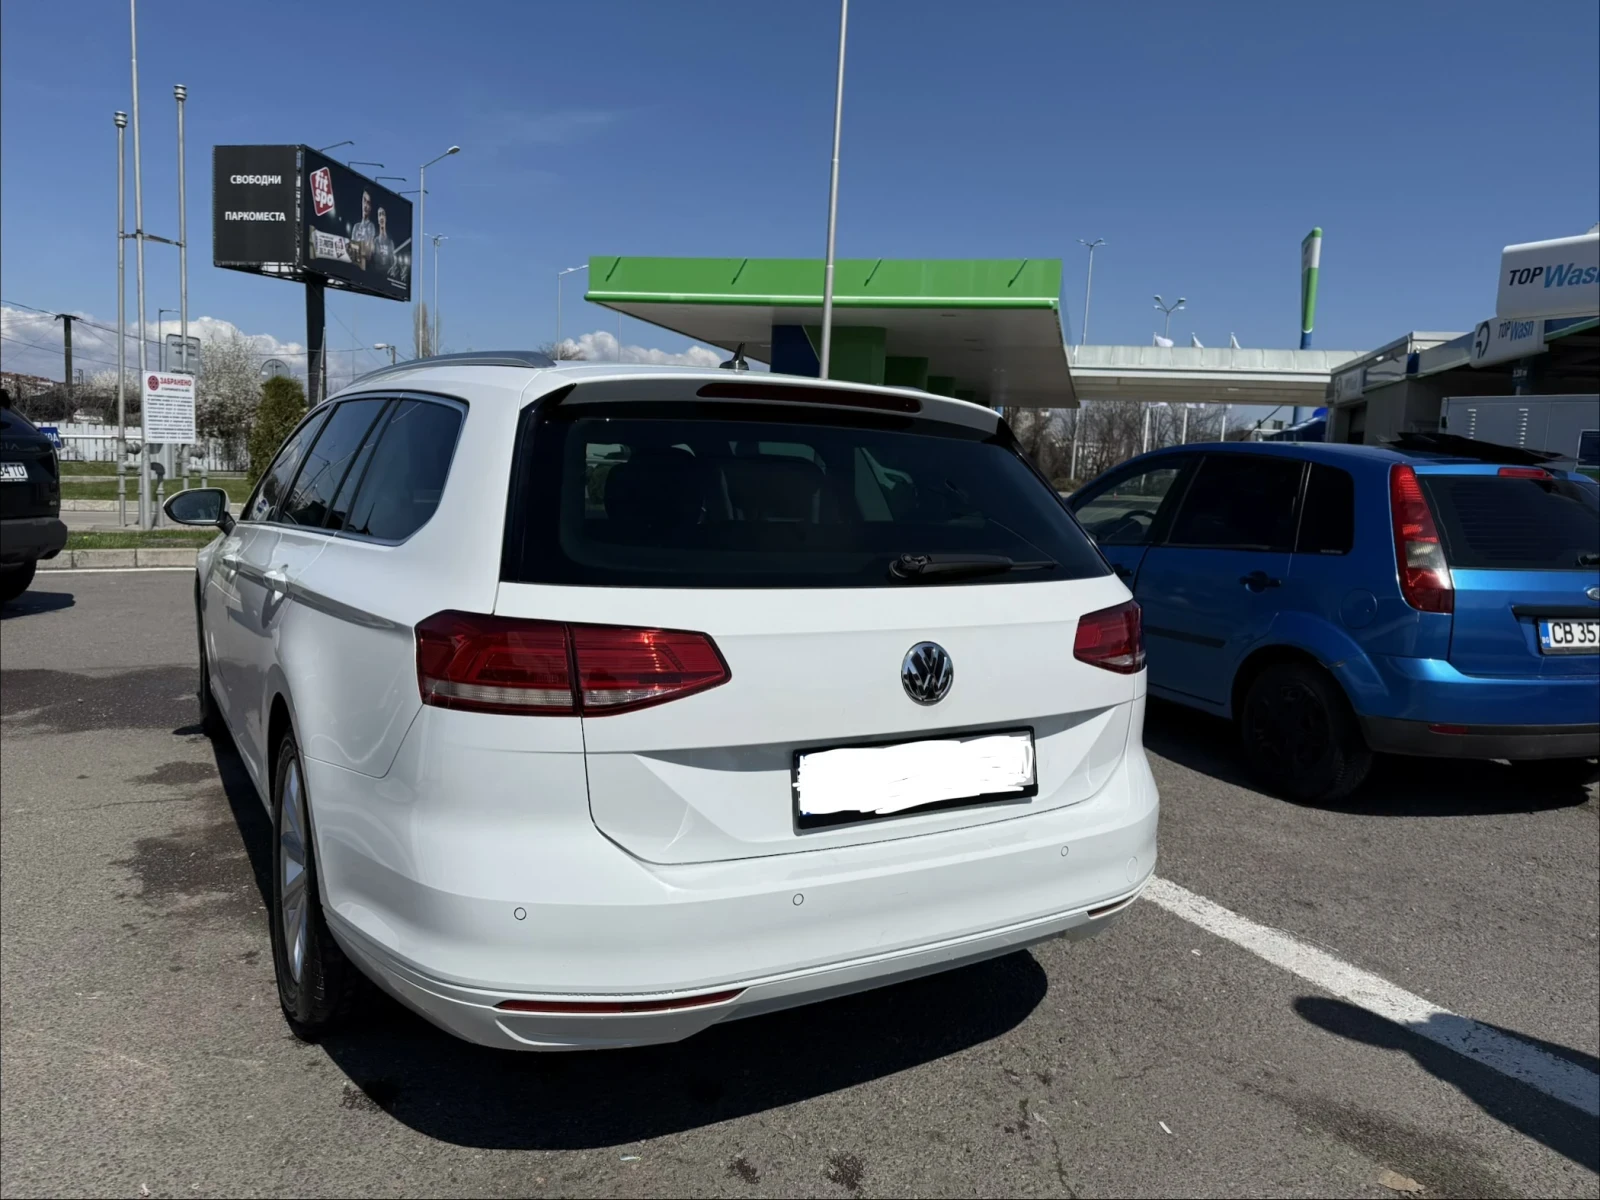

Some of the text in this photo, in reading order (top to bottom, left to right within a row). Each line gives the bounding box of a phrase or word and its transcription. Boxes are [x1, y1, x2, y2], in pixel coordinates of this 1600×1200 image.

[230, 174, 282, 186] СВОБОДНИ
[315, 170, 329, 191] fit
[314, 189, 334, 208] spo
[224, 210, 286, 222] ПАРКОМЕСТА
[1552, 621, 1574, 644] CB
